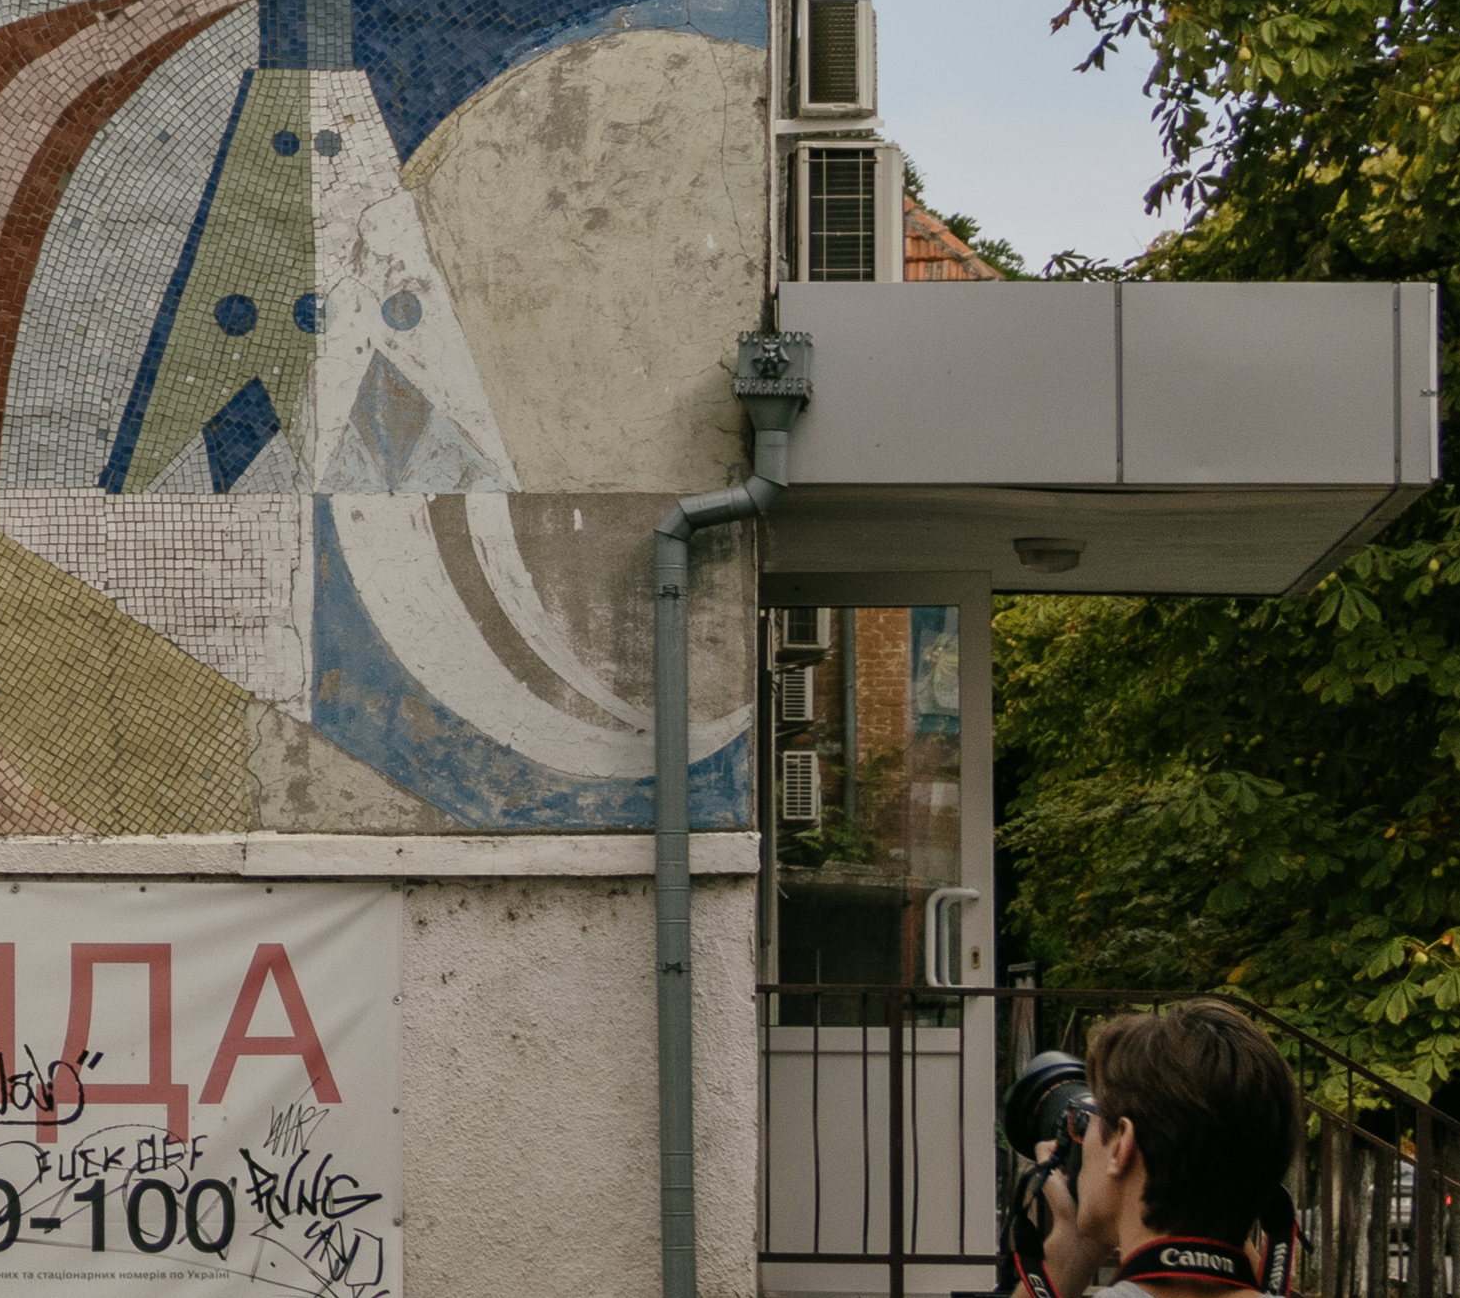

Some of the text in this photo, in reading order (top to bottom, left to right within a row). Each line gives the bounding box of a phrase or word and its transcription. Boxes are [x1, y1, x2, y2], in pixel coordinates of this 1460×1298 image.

[1159, 1248, 1235, 1274] Canon
[1266, 1242, 1288, 1296] anon
[22, 1270, 34, 1280] та
[37, 1269, 116, 1281] стаціонарних
[119, 1269, 167, 1281] номерів
[170, 1270, 184, 1280] по
[187, 1268, 230, 1281] Україні
